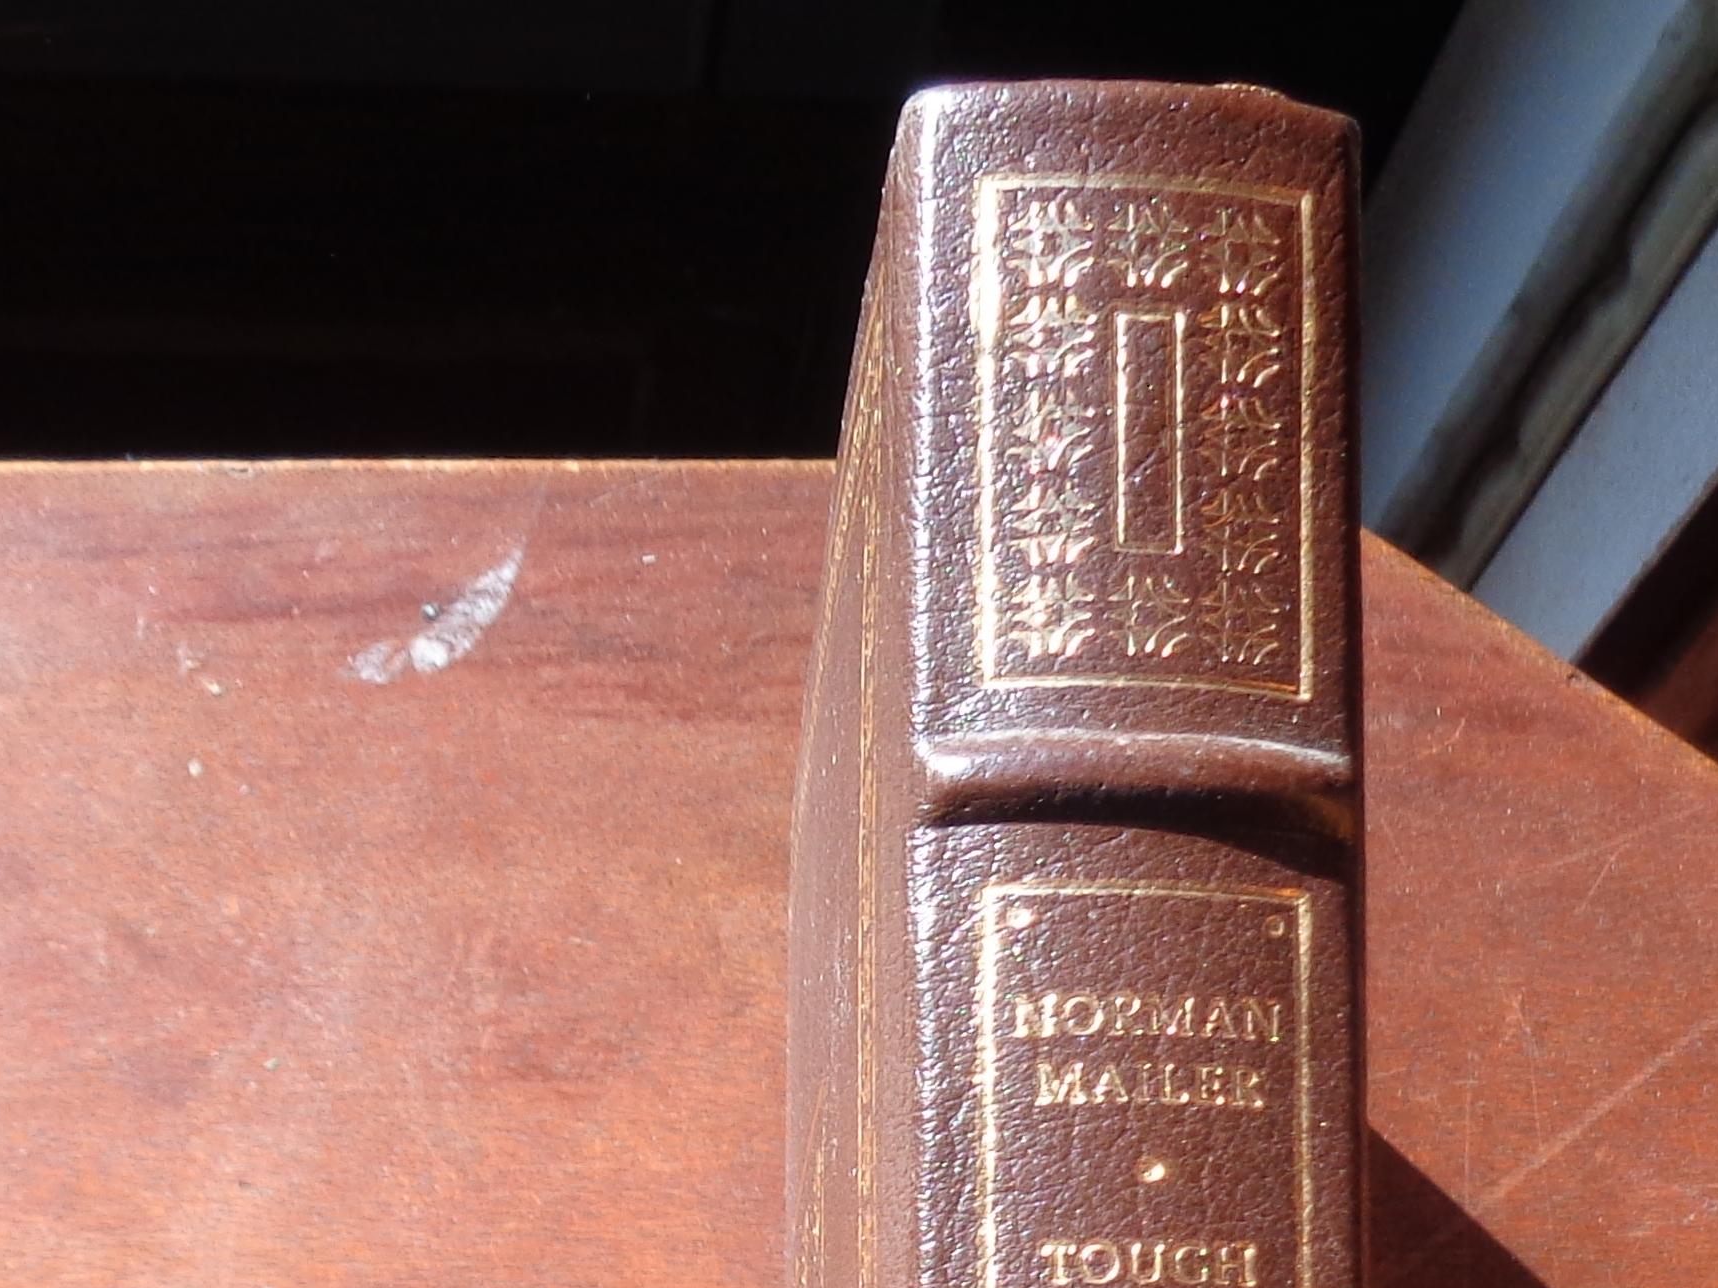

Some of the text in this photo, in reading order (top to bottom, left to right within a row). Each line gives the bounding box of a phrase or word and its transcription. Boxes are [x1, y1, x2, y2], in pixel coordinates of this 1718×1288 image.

[1012, 993, 1284, 1042] NORMAN
[1034, 1062, 1265, 1108] MAILER
[1040, 1240, 1258, 1288] TOUGH
